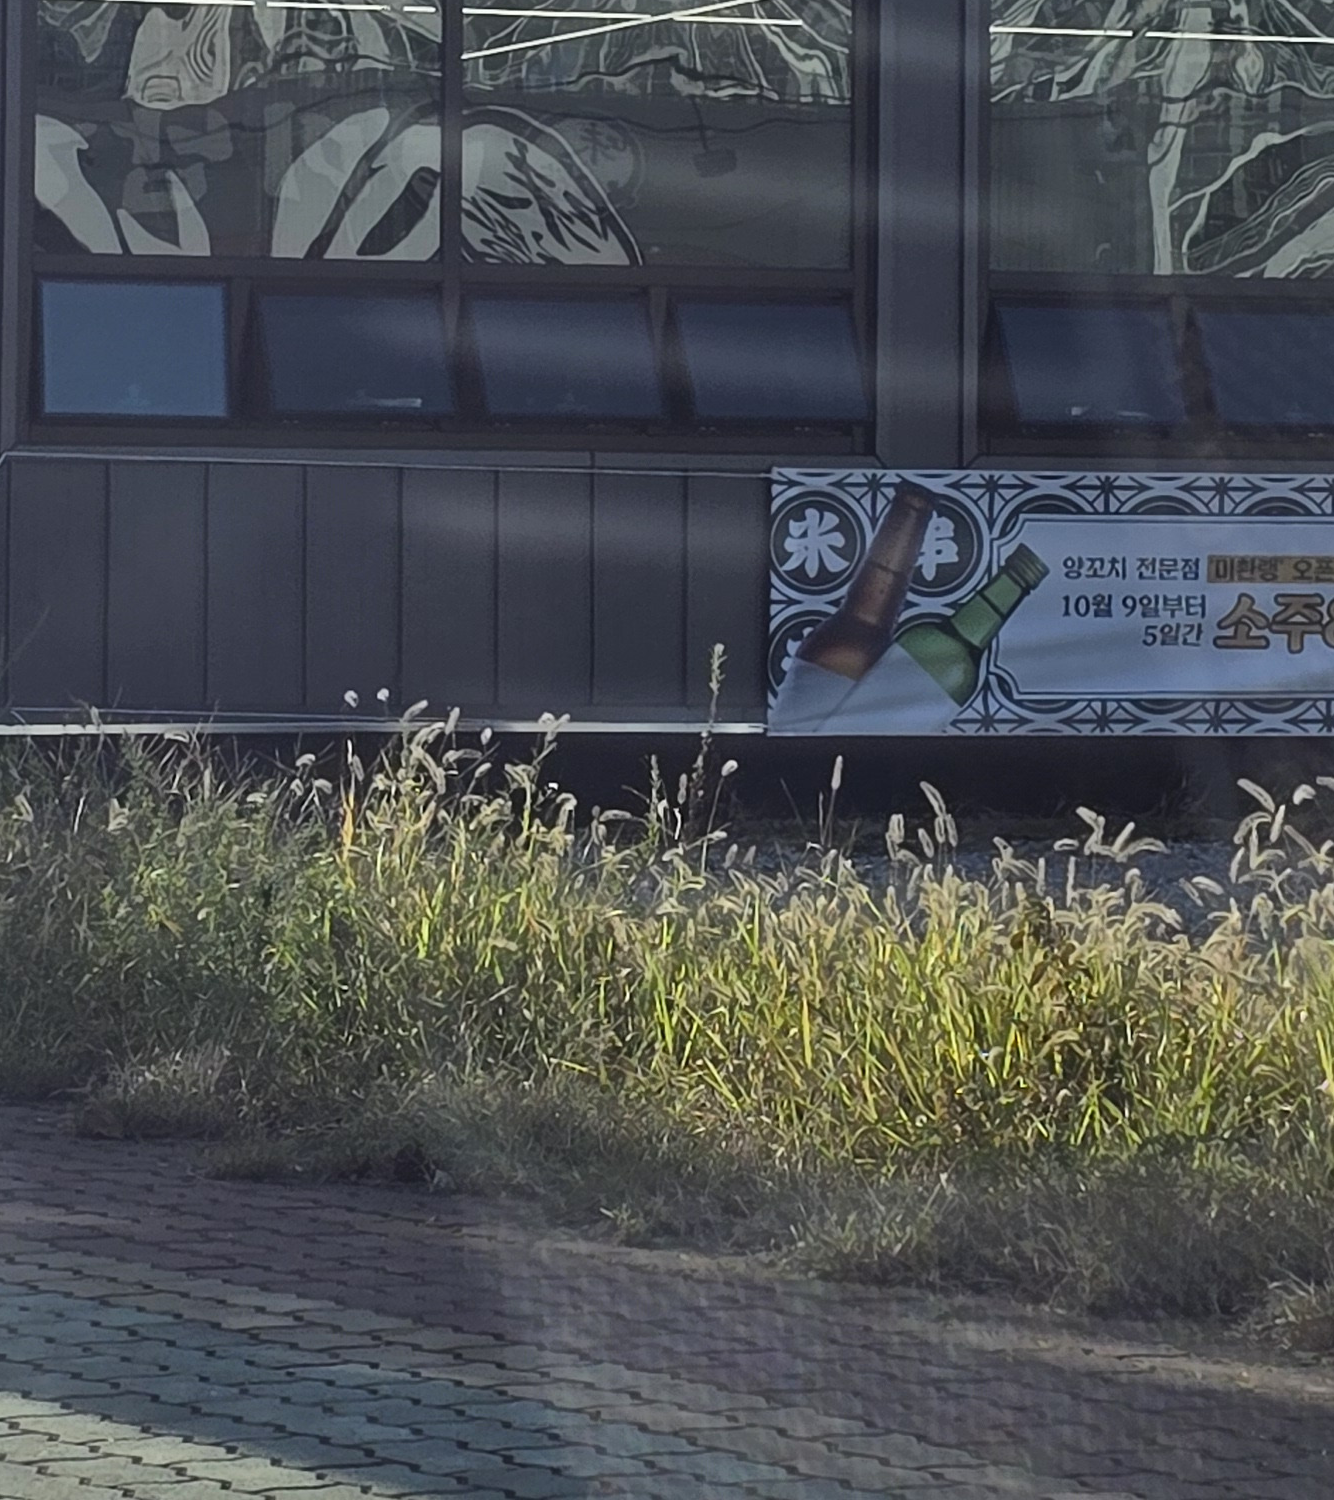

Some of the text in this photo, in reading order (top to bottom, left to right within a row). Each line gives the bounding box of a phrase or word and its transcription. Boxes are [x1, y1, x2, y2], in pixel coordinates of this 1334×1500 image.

[1062, 556, 1127, 581] 양꼬치
[1136, 557, 1200, 582] 전문점
[1061, 593, 1207, 619] 10월 9일부터
[1142, 622, 1205, 647] 5일간
